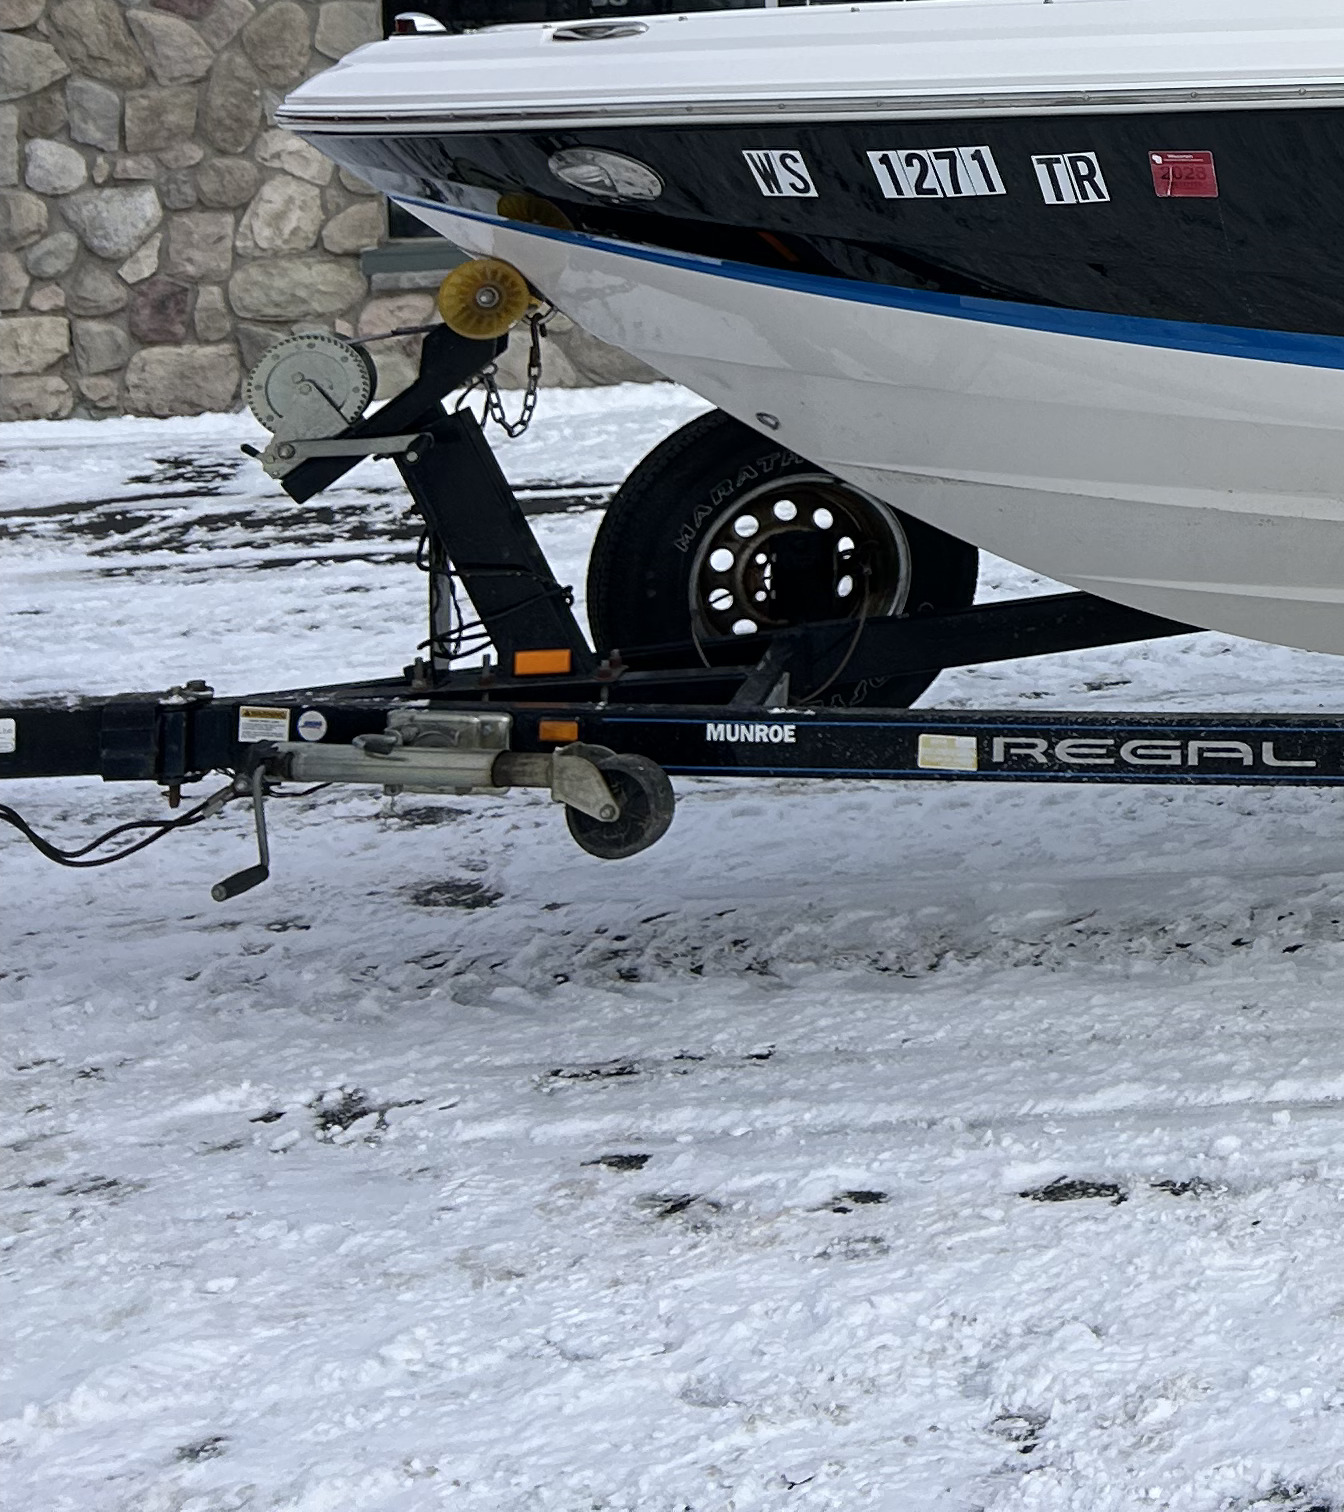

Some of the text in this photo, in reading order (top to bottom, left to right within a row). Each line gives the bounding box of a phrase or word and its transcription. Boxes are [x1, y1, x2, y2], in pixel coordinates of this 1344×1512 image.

[748, 146, 1107, 202] WS 1271 TR
[706, 723, 796, 744] MUNROE
[994, 735, 1318, 767] REGAL
